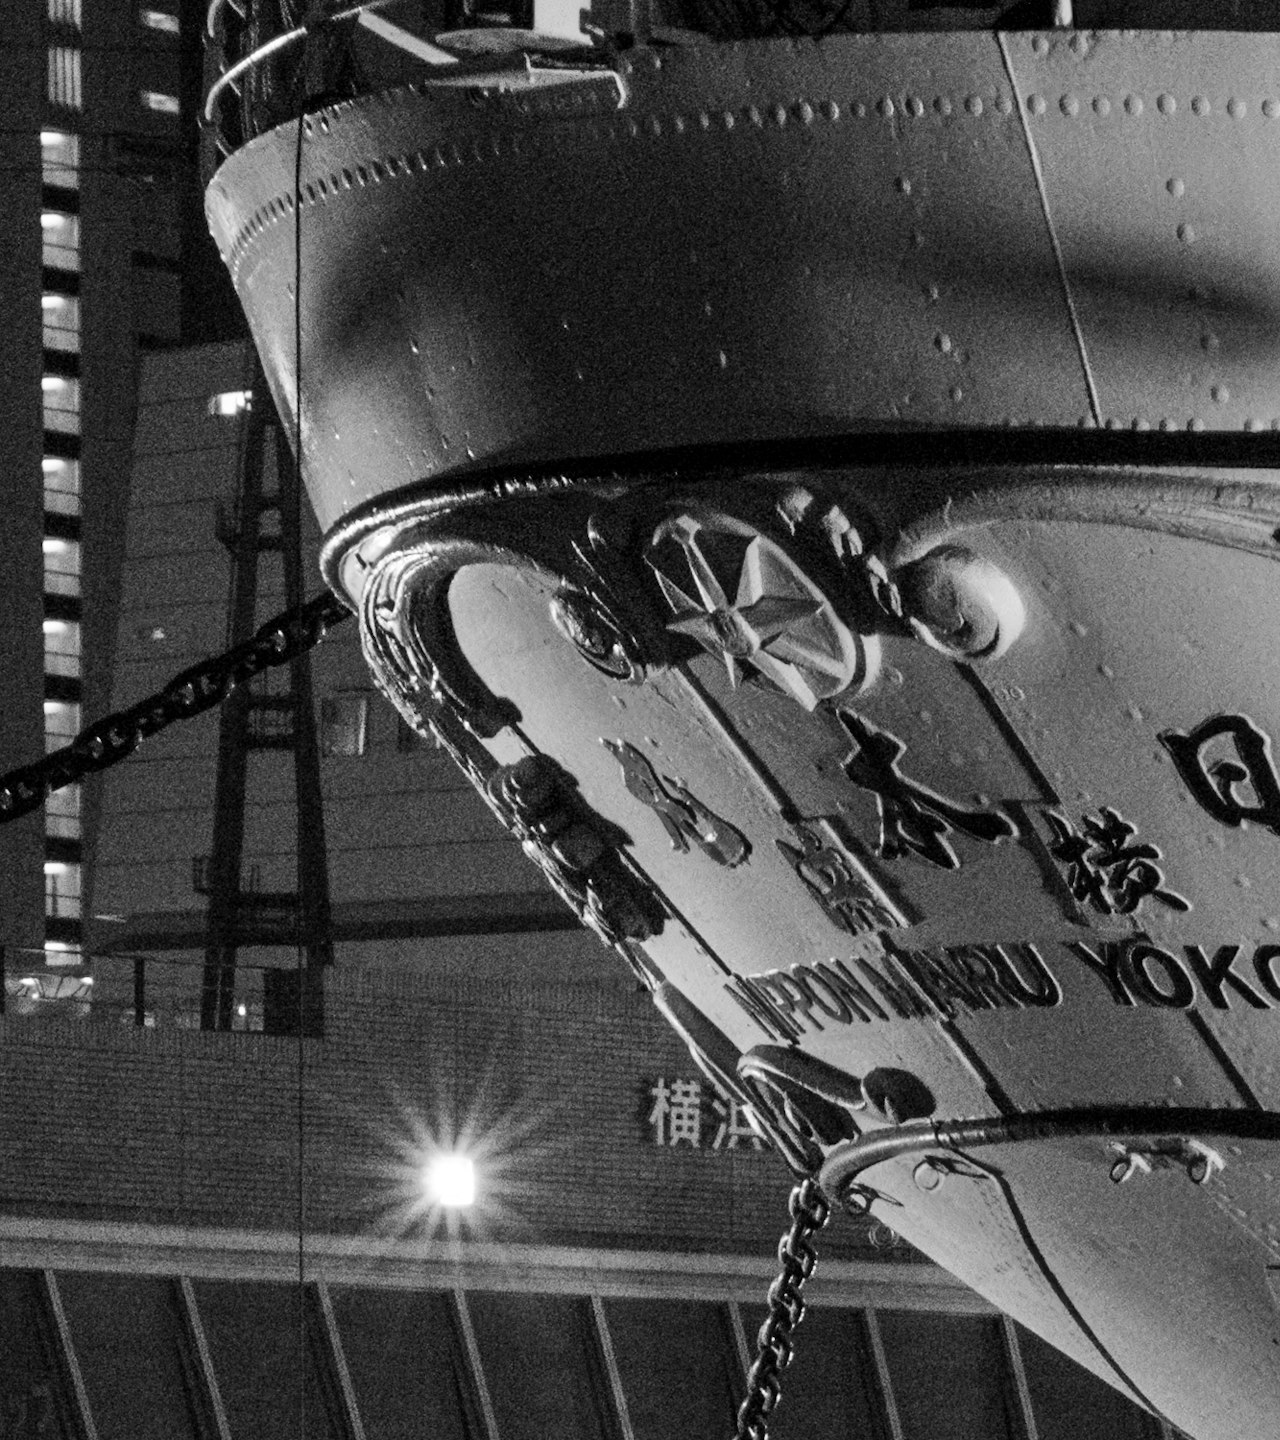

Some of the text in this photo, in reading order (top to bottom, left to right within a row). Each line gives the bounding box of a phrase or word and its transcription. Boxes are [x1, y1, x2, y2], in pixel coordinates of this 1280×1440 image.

[723, 953, 892, 1046] NIPPON
[853, 940, 1065, 1022] MARU
[648, 1077, 765, 1151] 横浜
